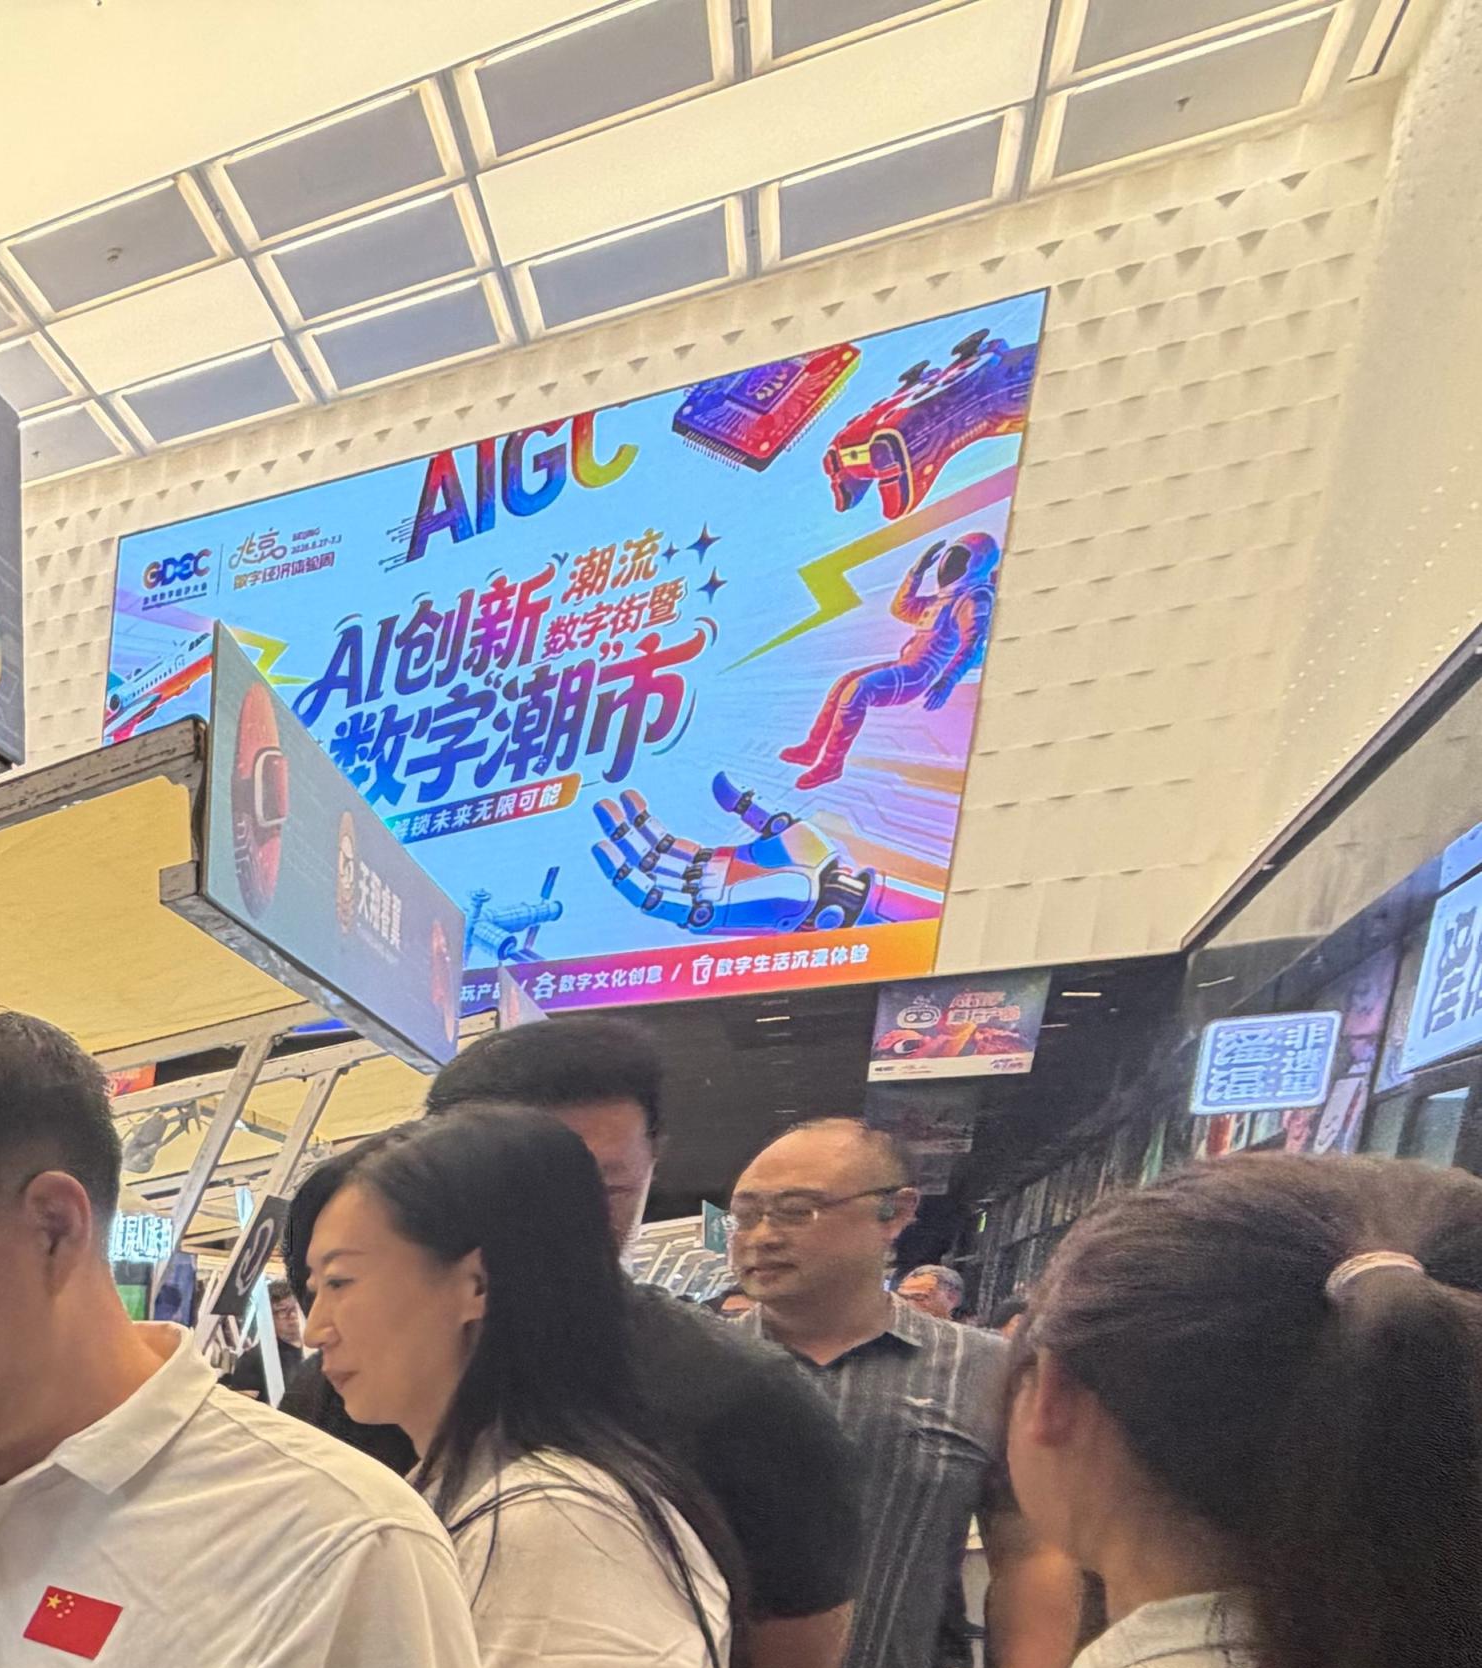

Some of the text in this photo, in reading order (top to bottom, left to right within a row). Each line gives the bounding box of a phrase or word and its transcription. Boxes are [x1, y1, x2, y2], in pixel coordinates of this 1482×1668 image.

[406, 409, 640, 563] AIGC
[142, 548, 212, 590] GDEC
[562, 528, 665, 605] 潮流
[291, 562, 557, 728] AI创新
[541, 578, 687, 659] 数字街暨
[392, 782, 563, 842] 解锁未来无限可能
[557, 964, 663, 993] 数字文化创意
[714, 942, 871, 979] 数字生活沉浸体验
